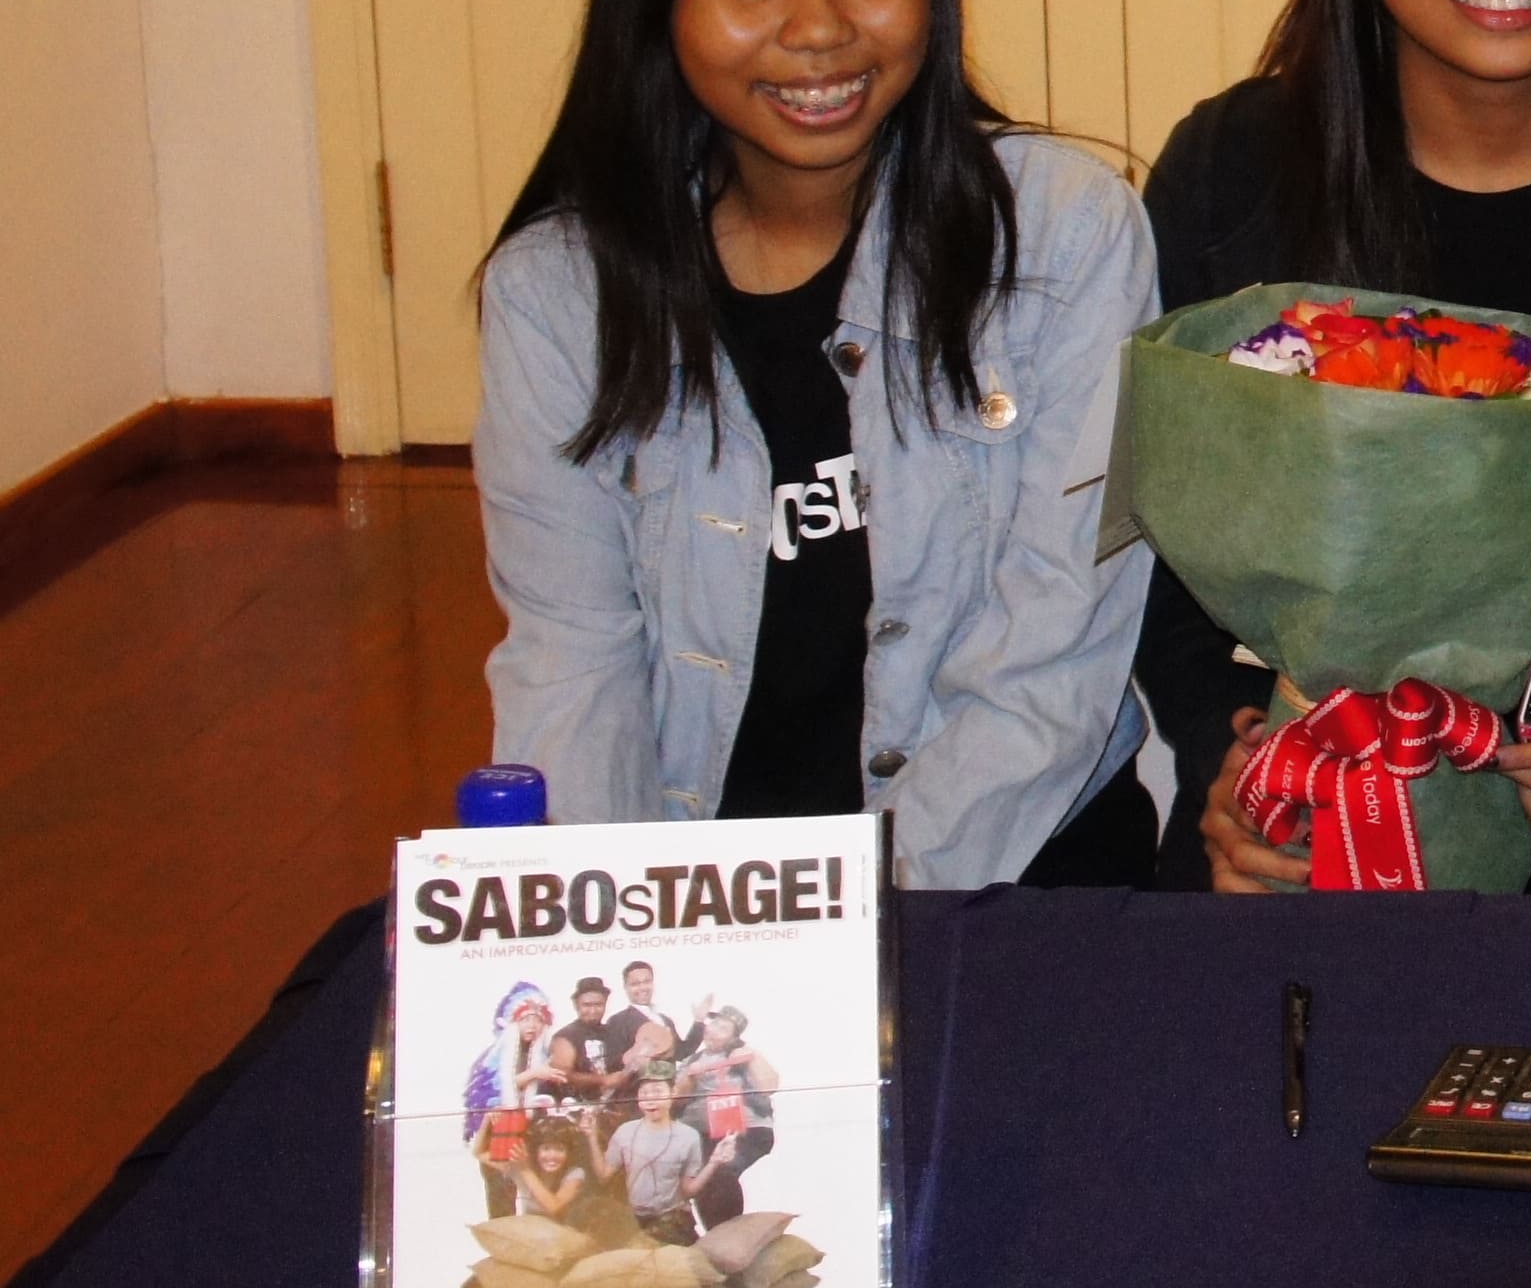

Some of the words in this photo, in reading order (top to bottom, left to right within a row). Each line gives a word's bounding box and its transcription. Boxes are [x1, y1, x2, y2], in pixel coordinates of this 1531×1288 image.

[1363, 774, 1382, 825] Today
[460, 947, 484, 961] AN
[489, 938, 625, 958] IMPROVAMAZING
[630, 933, 679, 950] SHOW
[682, 931, 712, 946] FOR
[716, 927, 800, 944] EVERYONE!
